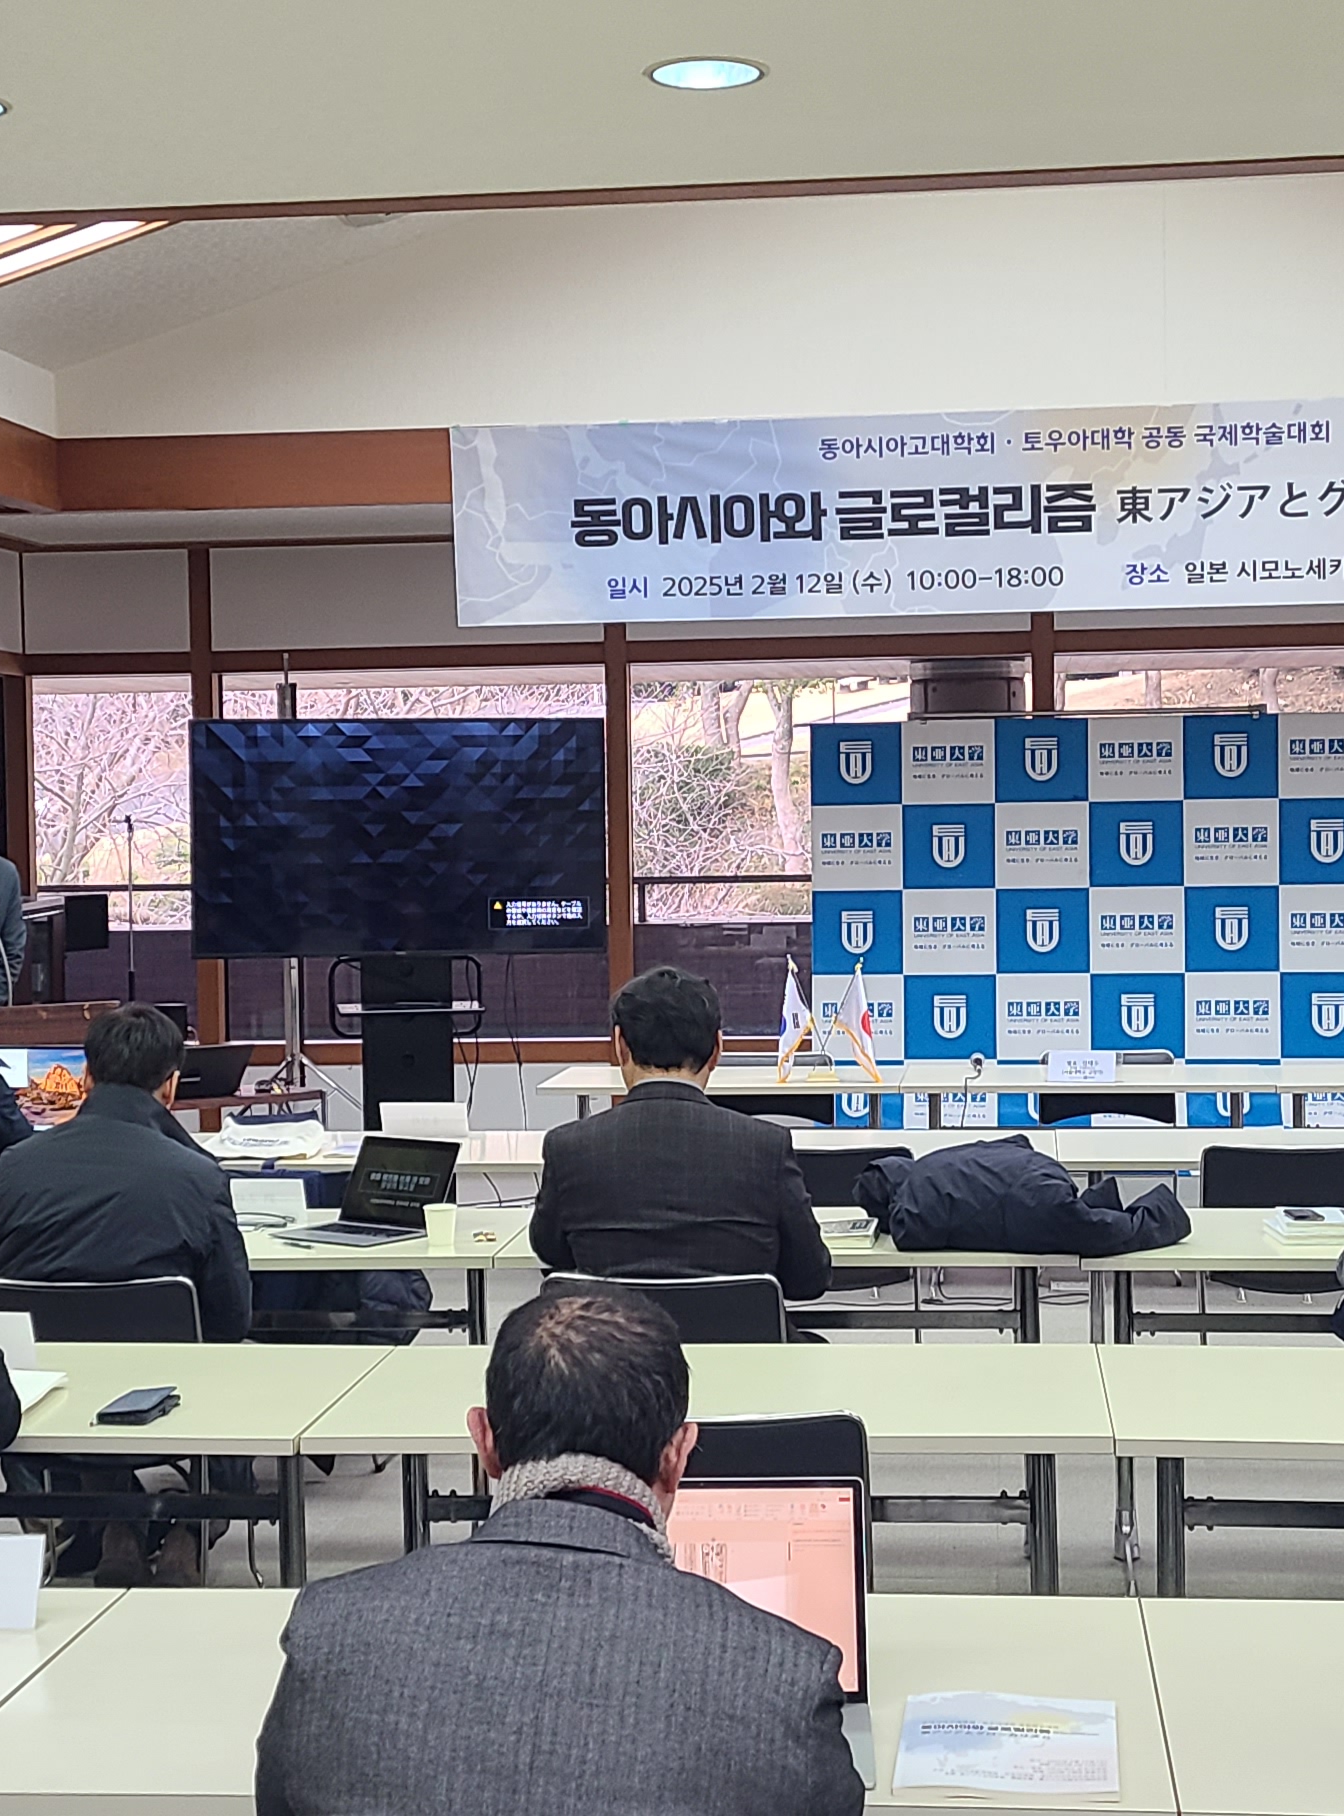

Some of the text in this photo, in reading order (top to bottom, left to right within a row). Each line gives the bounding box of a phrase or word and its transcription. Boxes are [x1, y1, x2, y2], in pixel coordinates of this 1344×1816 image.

[818, 420, 1331, 461] 동아시아고대학회 토우아대학 공동 국제학술대회
[570, 491, 828, 548] 동아시아와
[834, 483, 1097, 541] 글로컬리즘
[607, 576, 649, 600] 일시
[662, 574, 743, 598] 2025년
[751, 572, 787, 596] 2월
[795, 571, 844, 595] 12일
[852, 568, 893, 596] (수)
[1125, 562, 1171, 586] 장소
[1184, 560, 1230, 585] 일본
